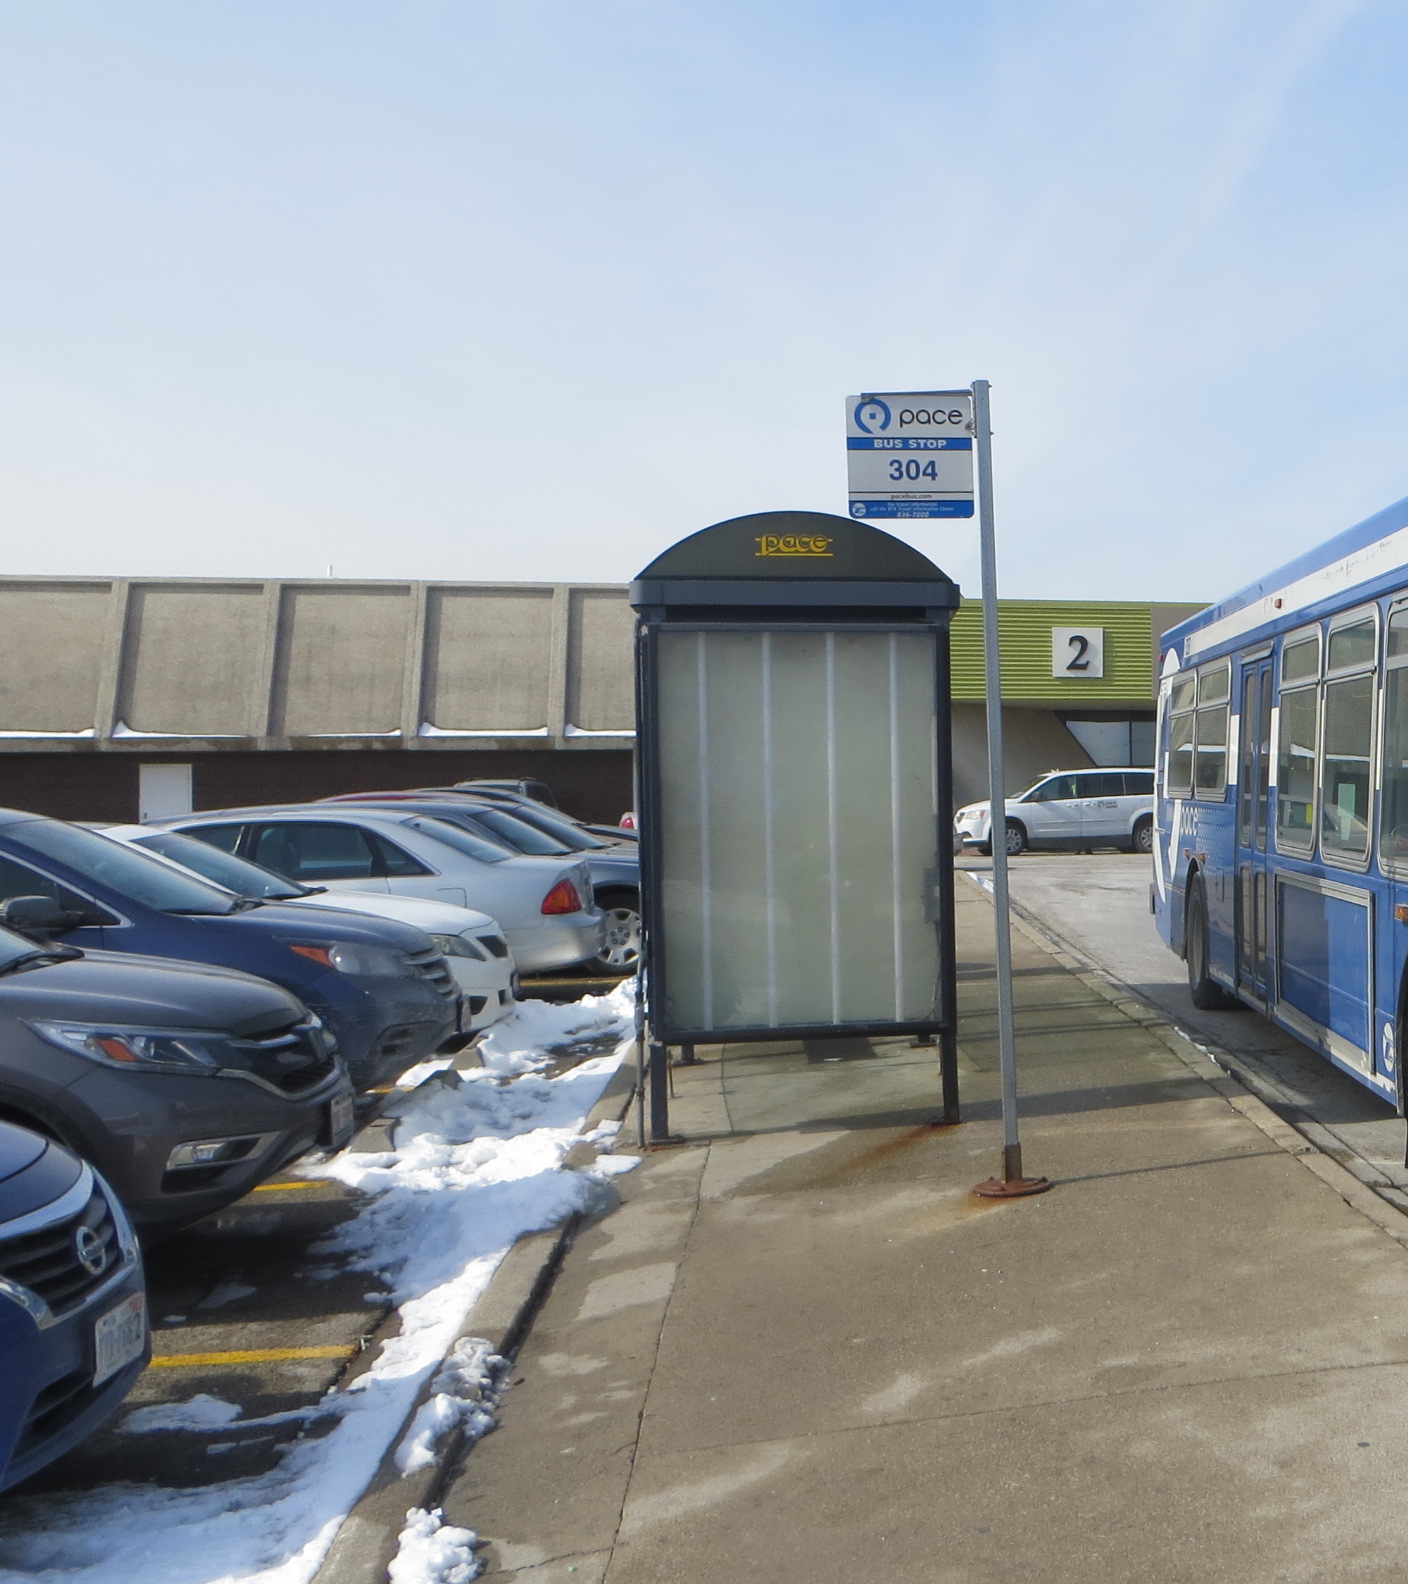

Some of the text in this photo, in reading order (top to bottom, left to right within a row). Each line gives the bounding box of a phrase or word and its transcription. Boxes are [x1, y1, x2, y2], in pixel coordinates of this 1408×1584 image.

[899, 409, 963, 428] pace
[873, 439, 947, 449] BUS STOP
[889, 459, 938, 481] 304
[761, 534, 829, 556] pace
[1066, 635, 1090, 670] 2
